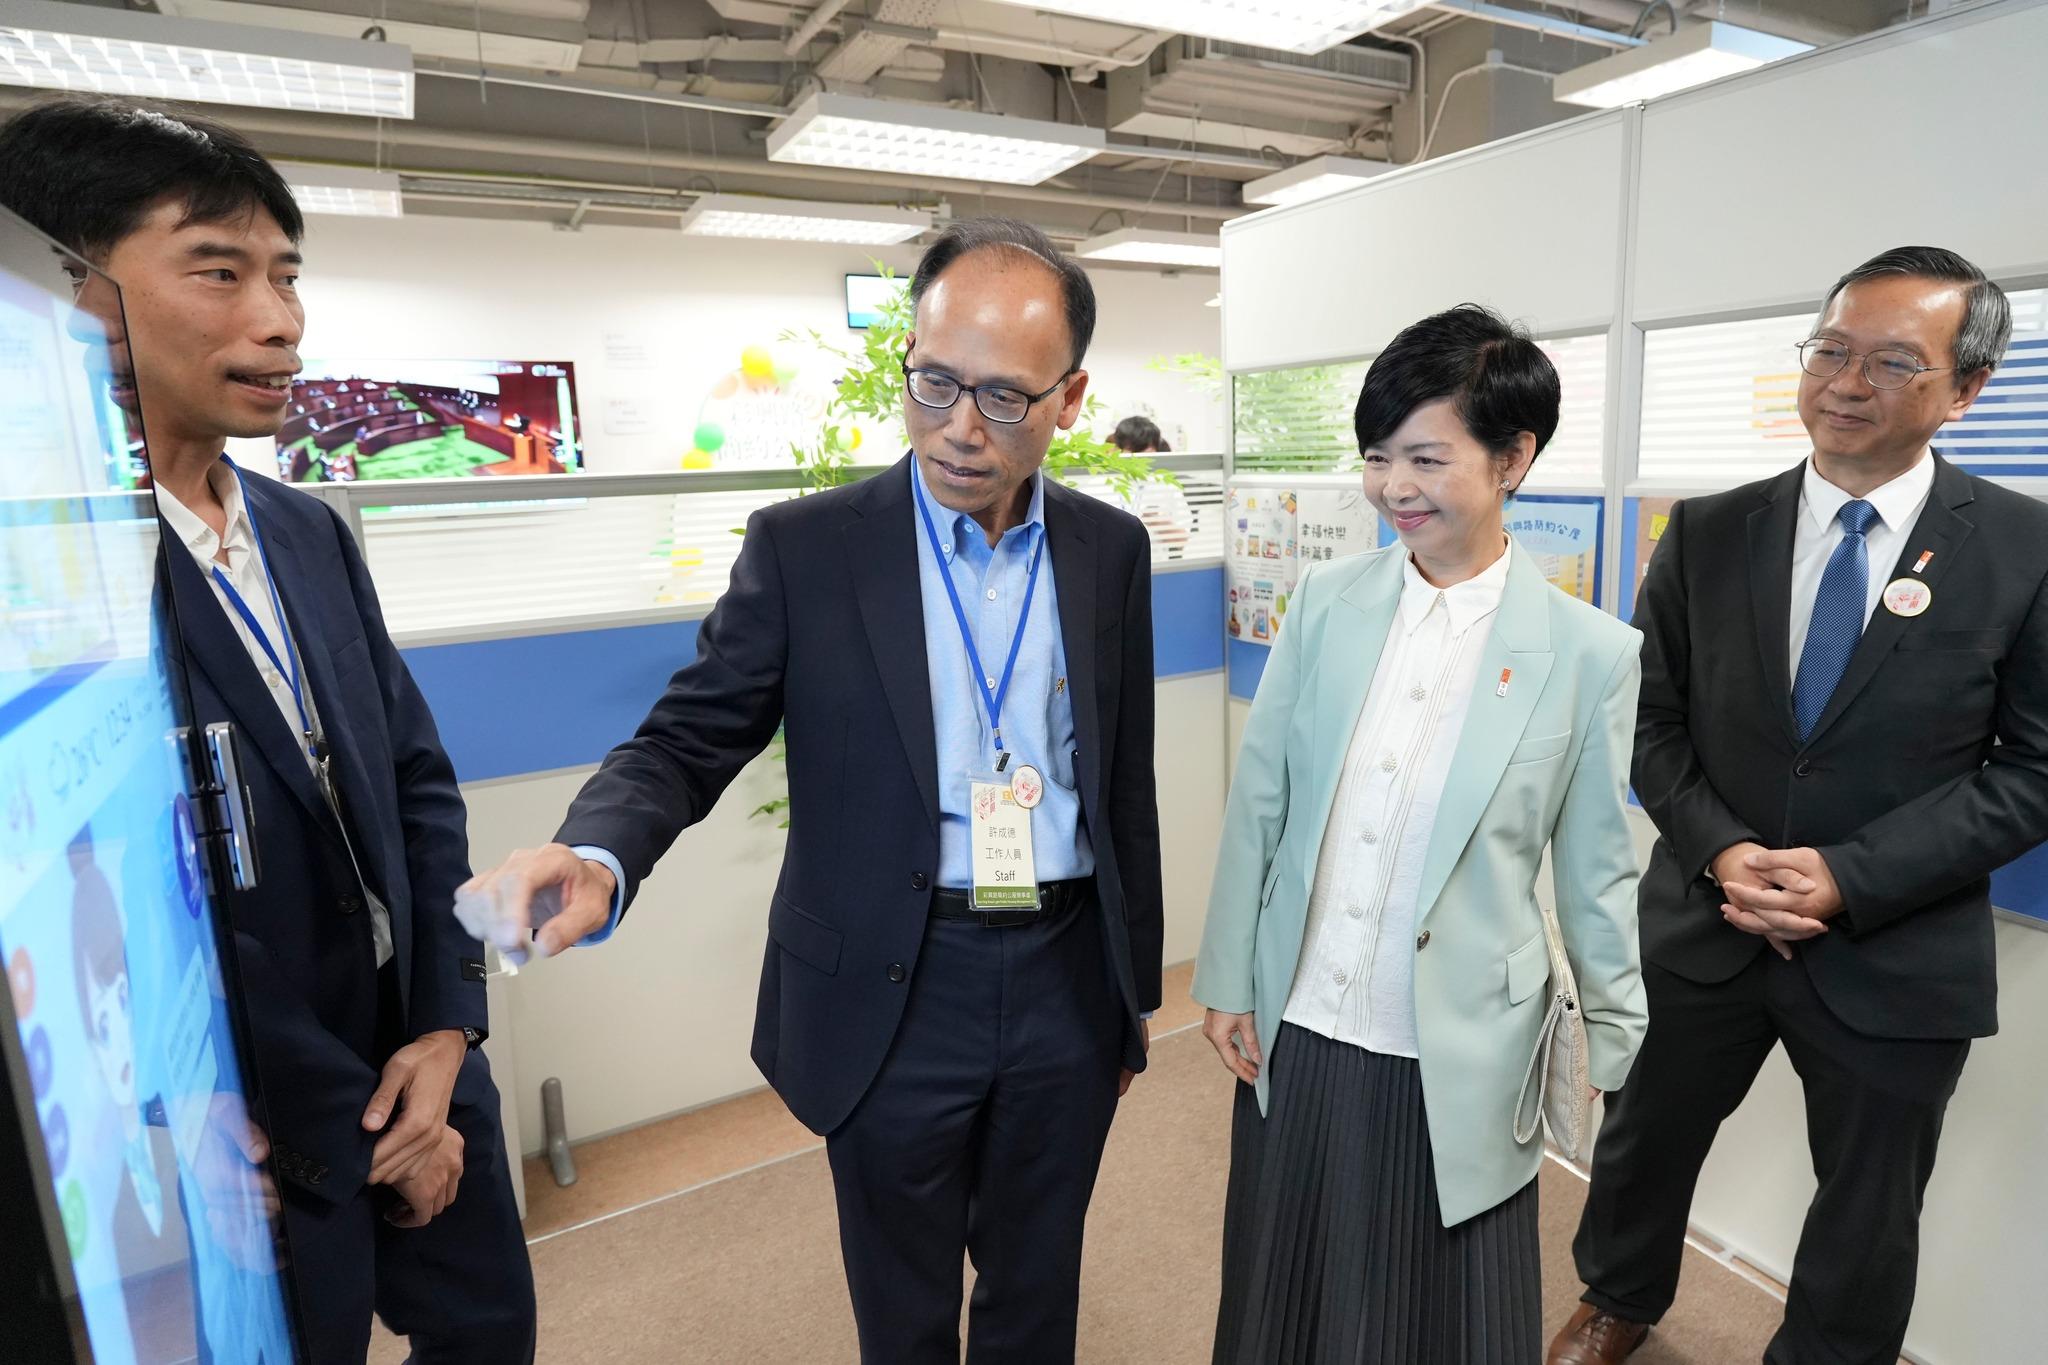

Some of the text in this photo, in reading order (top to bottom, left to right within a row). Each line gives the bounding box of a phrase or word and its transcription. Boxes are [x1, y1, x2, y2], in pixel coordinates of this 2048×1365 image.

[1301, 523, 1346, 541] 幸福快樂
[985, 847, 1022, 861] 工作人員
[994, 870, 1016, 882] Staff
